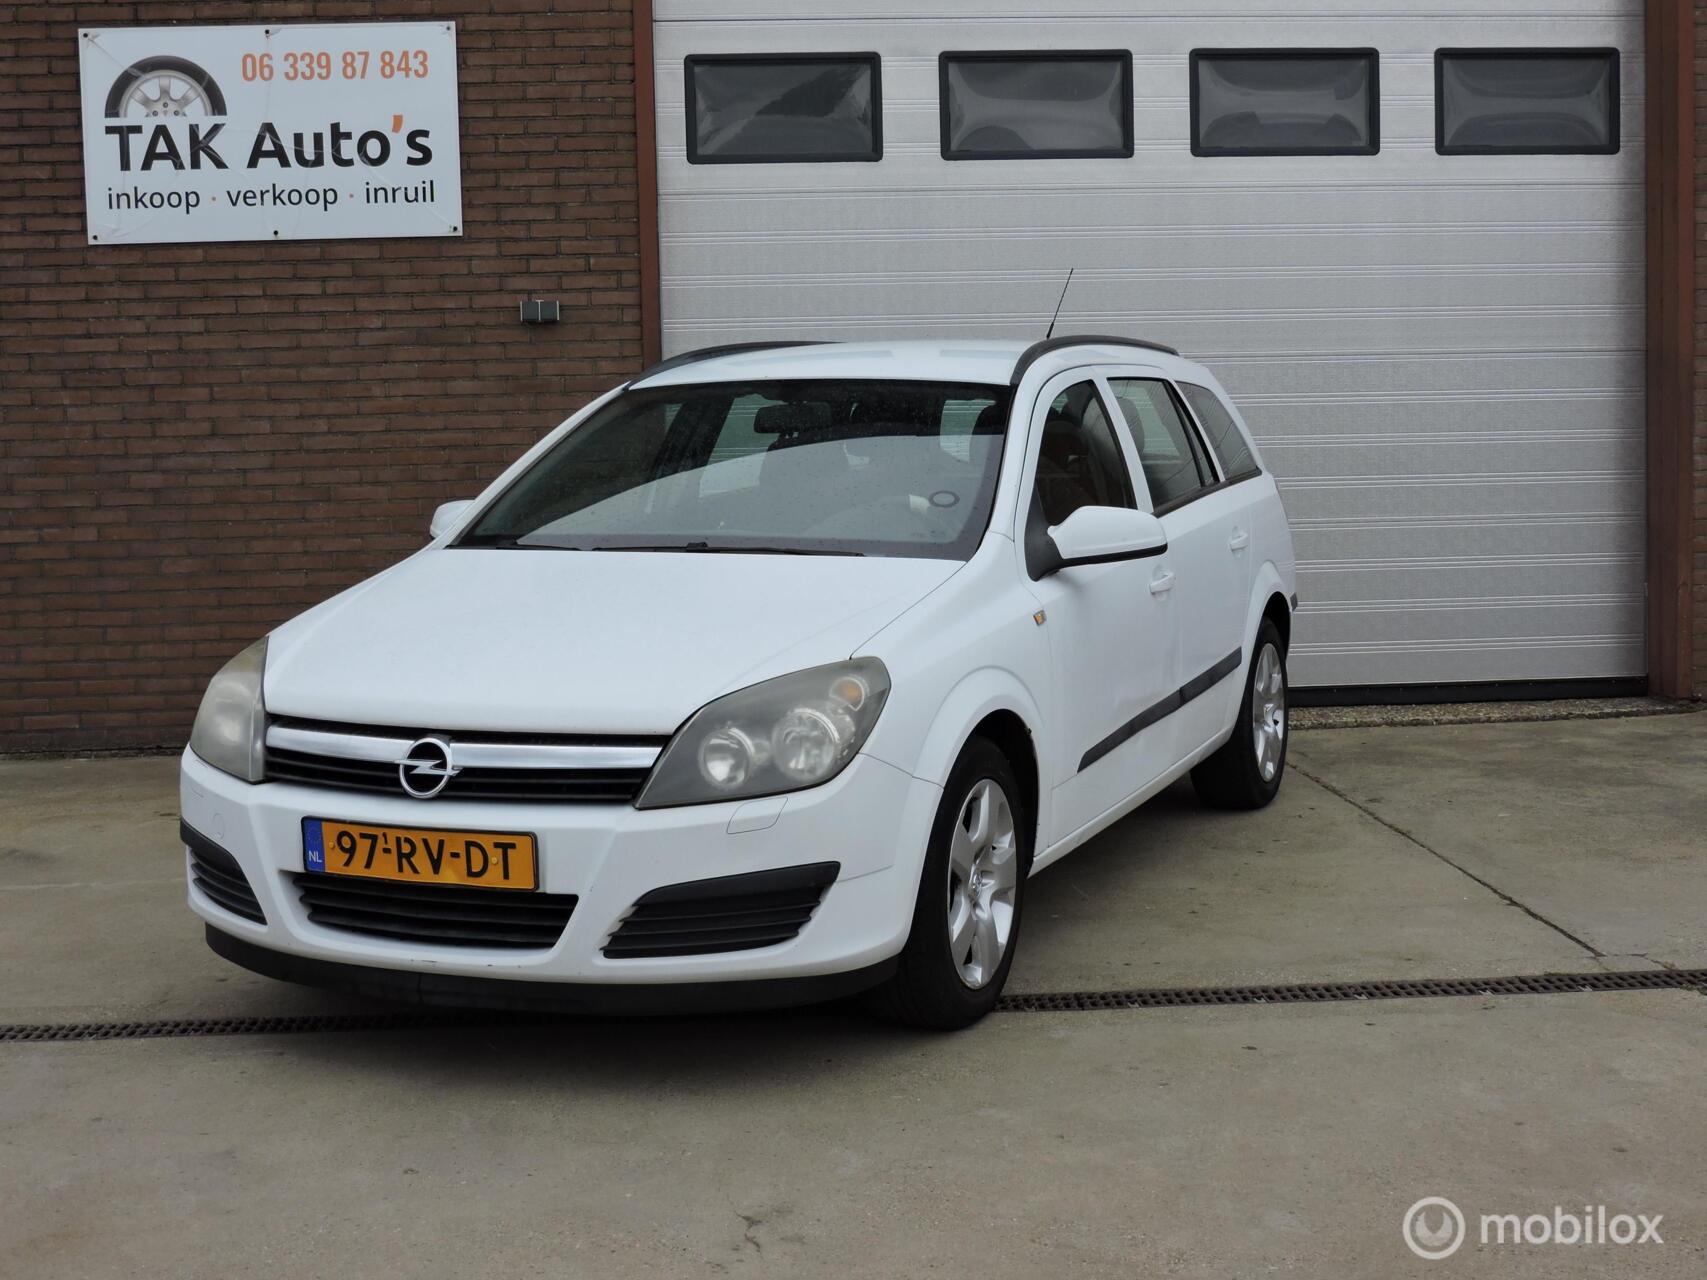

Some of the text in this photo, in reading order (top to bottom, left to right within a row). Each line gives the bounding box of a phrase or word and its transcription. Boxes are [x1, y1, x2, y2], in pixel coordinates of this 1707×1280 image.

[241, 49, 429, 82] 06 339 87 843
[105, 114, 433, 171] TAK Auto's
[107, 180, 435, 214] inkoop verkoop inruil
[308, 850, 322, 863] NL
[336, 830, 517, 880] 97-RV-DT
